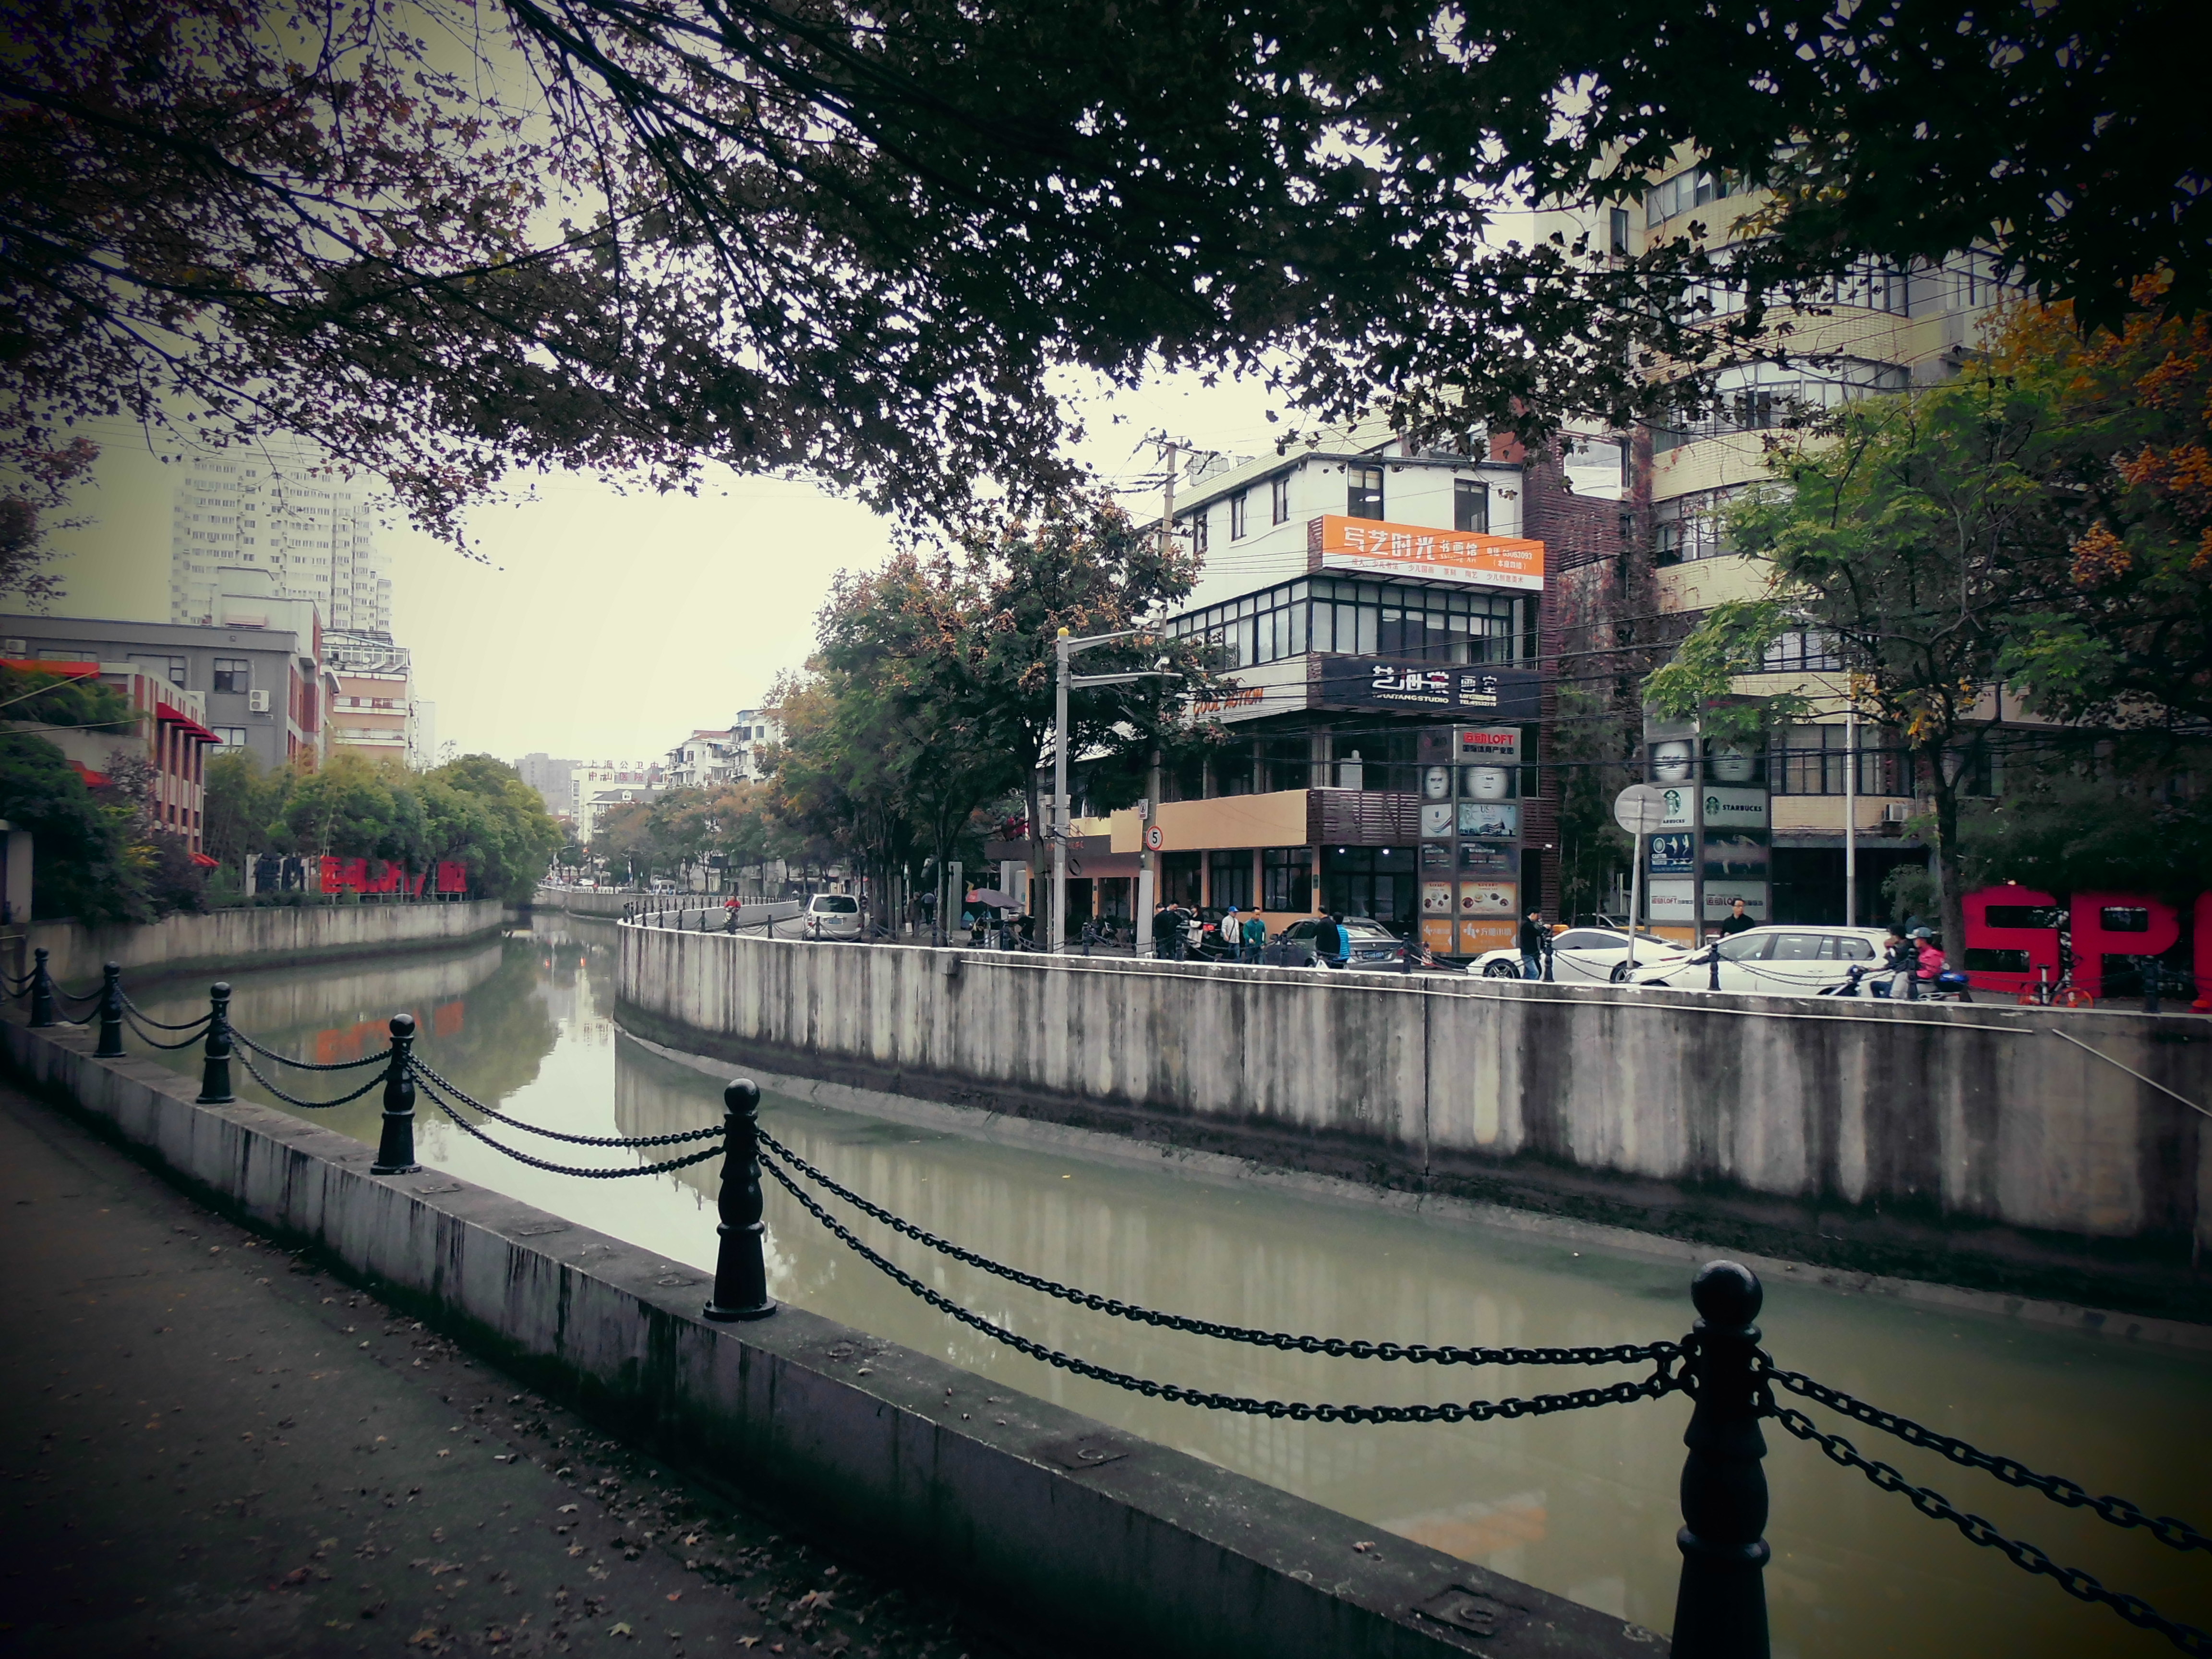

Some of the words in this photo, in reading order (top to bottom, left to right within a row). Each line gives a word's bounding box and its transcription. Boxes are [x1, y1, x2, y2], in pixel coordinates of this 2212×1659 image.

[1344, 527, 1435, 560] 写艺时光
[1440, 540, 1478, 556] 书画馆
[1722, 804, 1763, 812] STARBUCKS
[1152, 831, 1158, 844] 5
[1961, 885, 2212, 1001] SP
